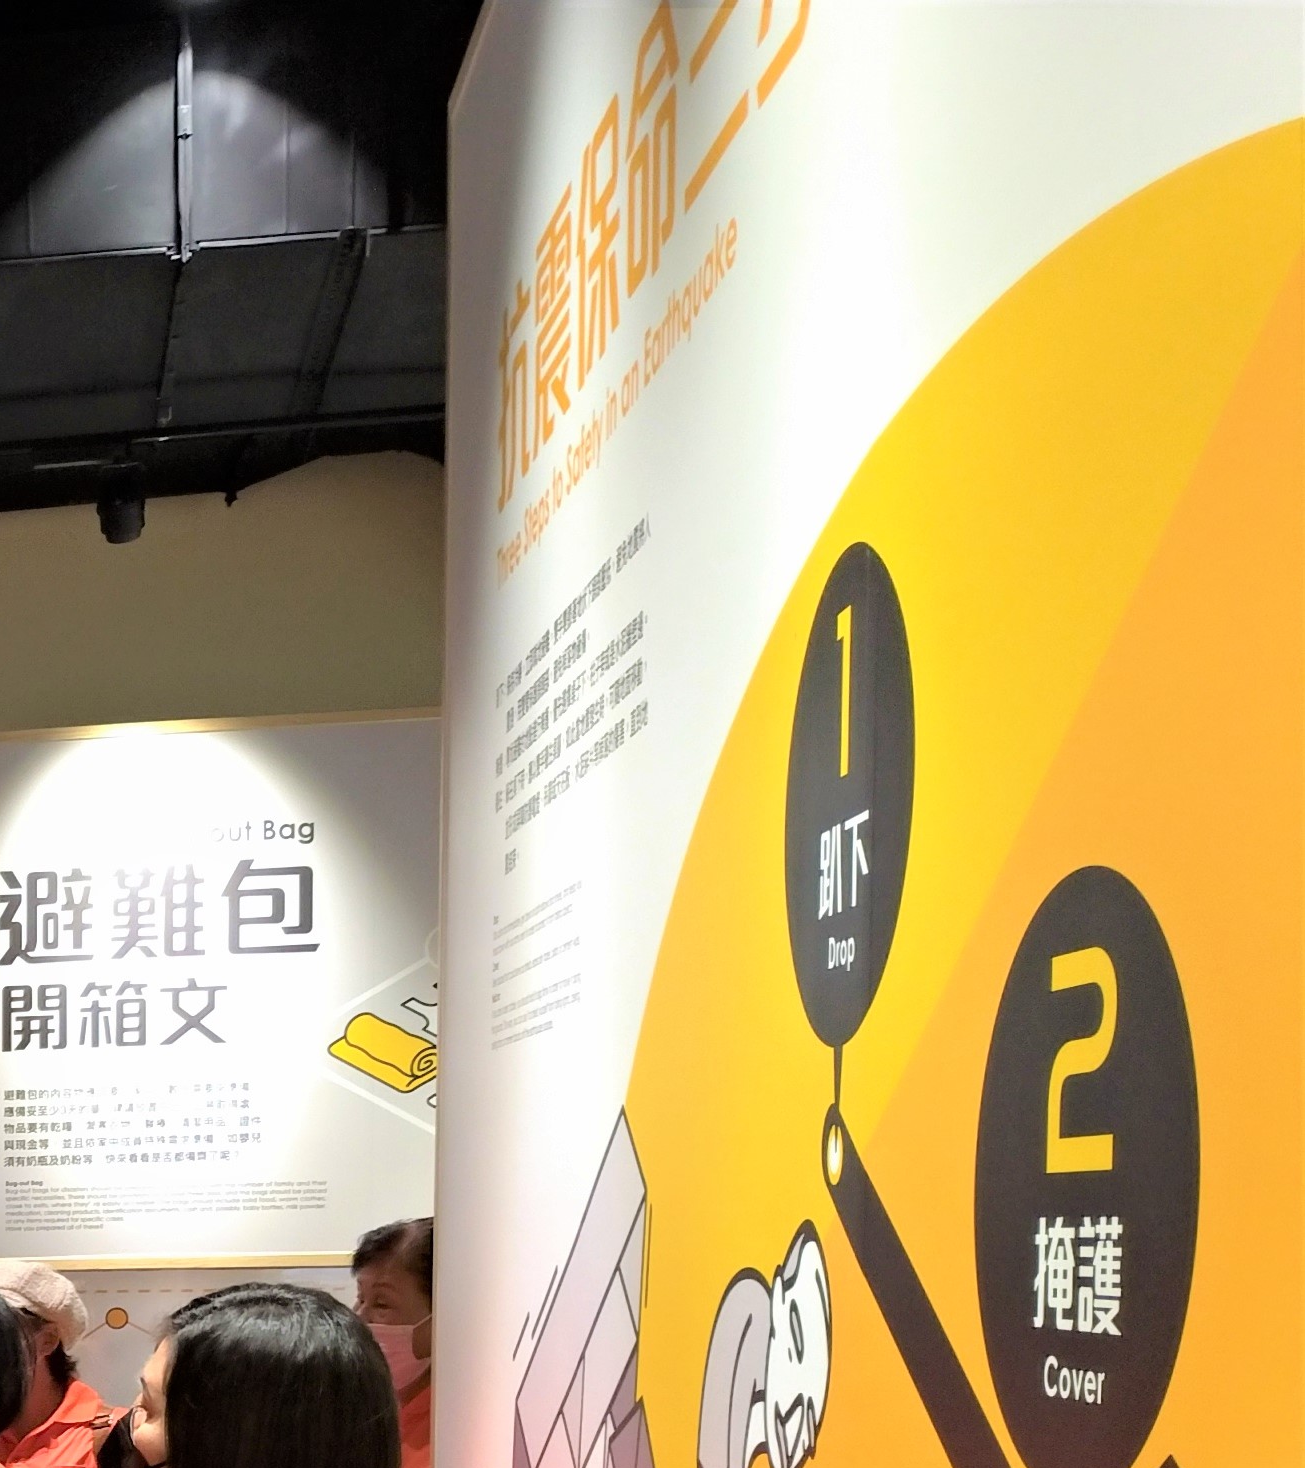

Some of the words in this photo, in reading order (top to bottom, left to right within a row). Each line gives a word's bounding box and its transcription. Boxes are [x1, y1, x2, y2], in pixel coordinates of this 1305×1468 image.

[497, 531, 521, 589] Three
[524, 491, 549, 548] Steps
[552, 466, 563, 514] to
[566, 410, 602, 495] Safety
[606, 387, 618, 441] in
[621, 359, 639, 417] an
[643, 216, 738, 388] Earthquake
[836, 604, 852, 778] 1
[263, 819, 315, 845] Bag
[818, 809, 870, 920] 趴下
[828, 936, 855, 972] Drop
[1, 977, 228, 1052] 開箱文
[1045, 946, 1119, 1174] 2
[1032, 1215, 1124, 1338] 掩護
[1042, 1354, 1106, 1405] Cover
